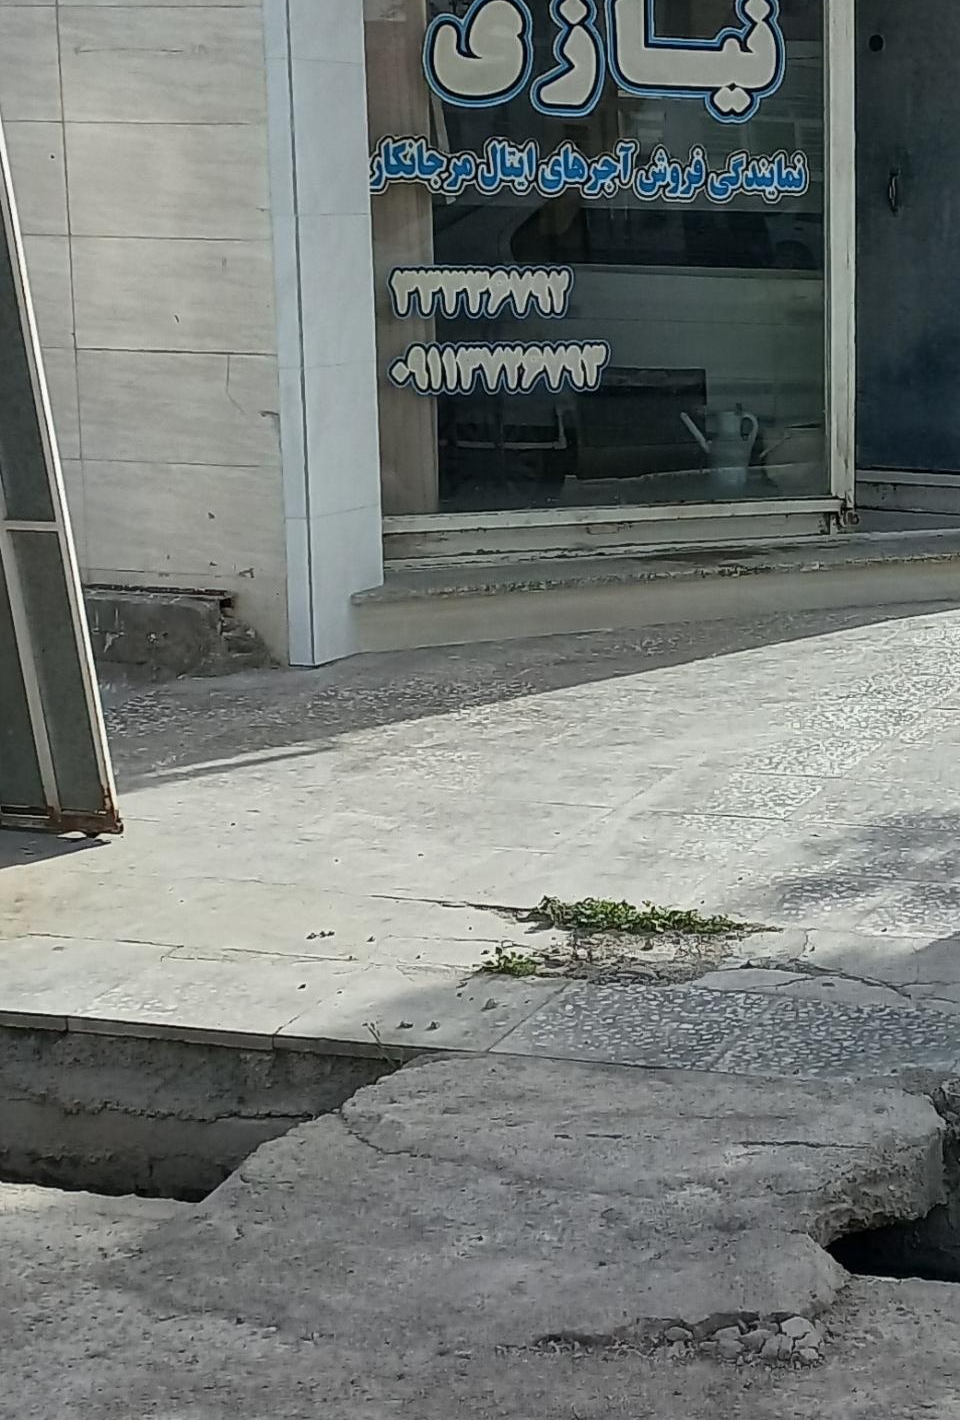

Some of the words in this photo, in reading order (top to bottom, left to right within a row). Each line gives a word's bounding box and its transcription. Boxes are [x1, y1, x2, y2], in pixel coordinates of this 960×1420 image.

[477, 136, 539, 192] ایتال
[540, 139, 638, 198] آجرهای
[636, 144, 707, 203] فروش
[706, 151, 810, 205] نمایندگی
